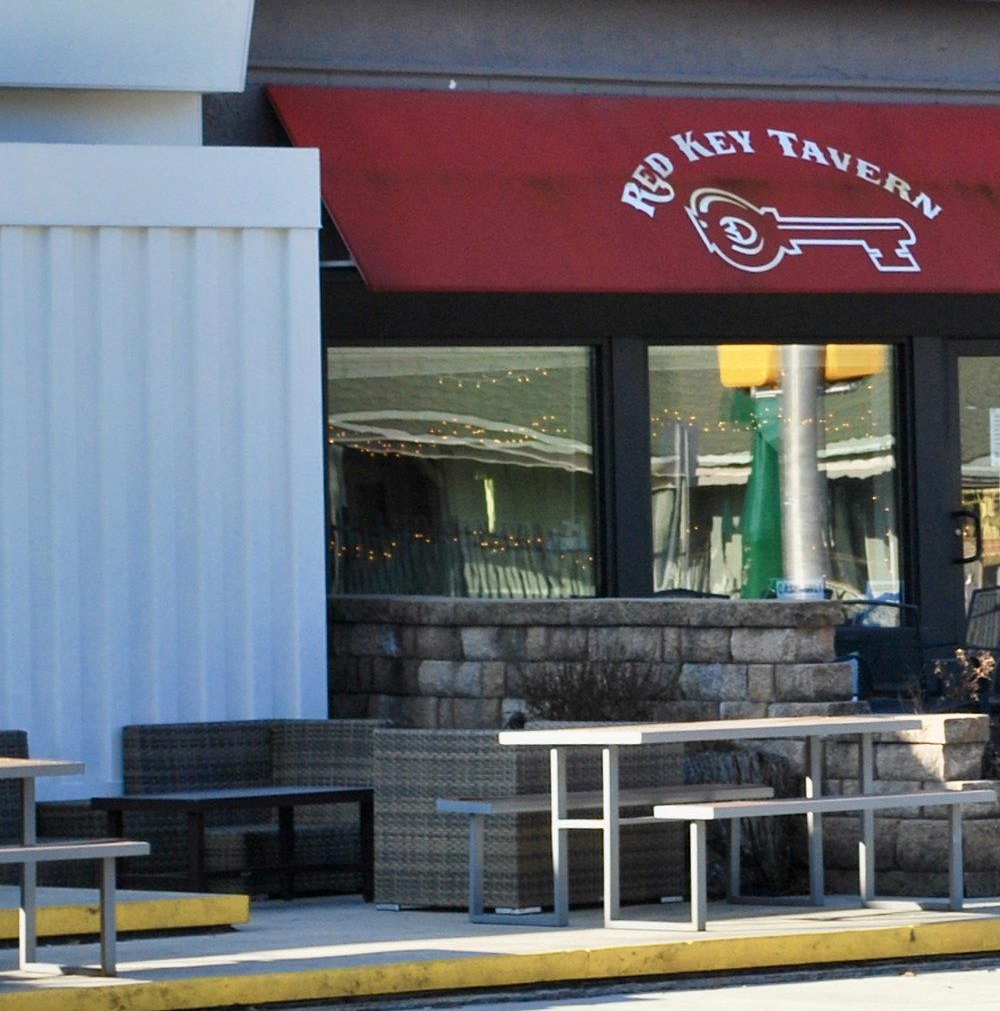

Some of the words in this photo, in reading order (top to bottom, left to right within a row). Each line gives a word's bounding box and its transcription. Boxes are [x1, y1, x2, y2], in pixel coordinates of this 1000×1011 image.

[621, 152, 676, 218] RED
[671, 130, 755, 163] KEY
[767, 128, 943, 220] TAVERN
